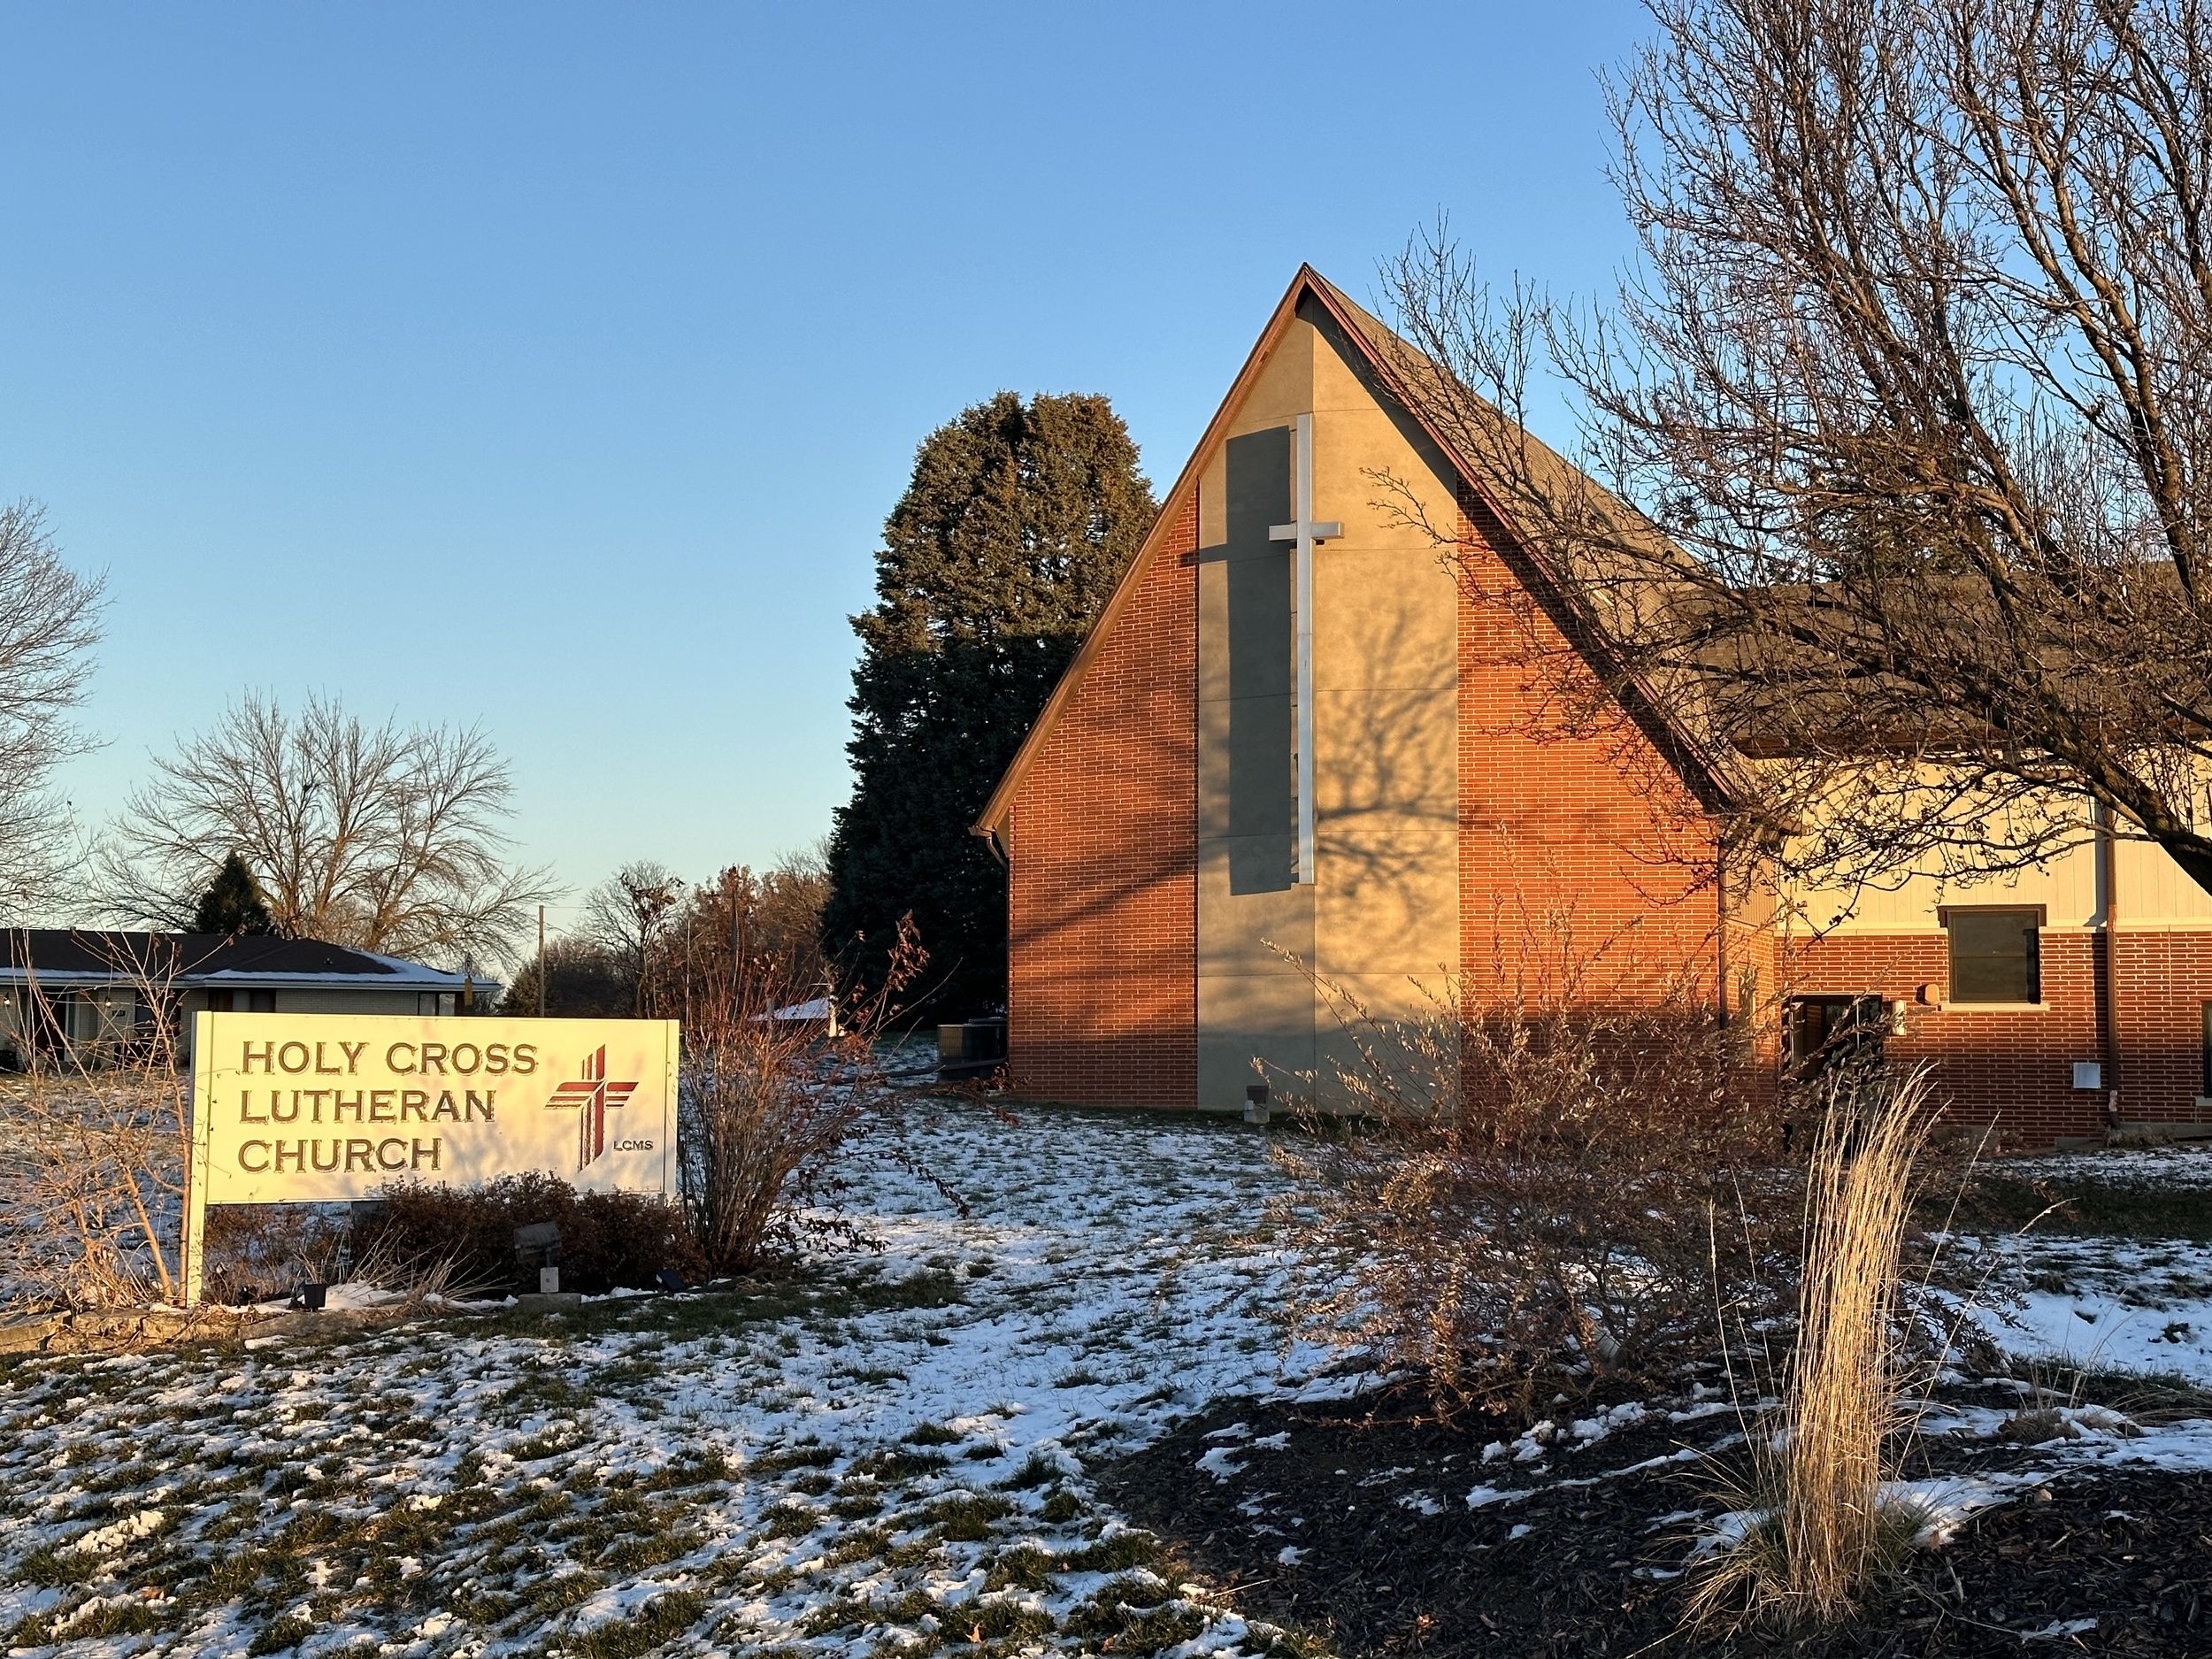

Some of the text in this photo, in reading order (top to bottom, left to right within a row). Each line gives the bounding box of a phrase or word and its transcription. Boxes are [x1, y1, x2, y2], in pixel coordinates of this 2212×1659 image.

[242, 1041, 538, 1075] HOLY CROSS
[240, 1089, 495, 1125] LUTHERAN
[238, 1137, 442, 1173] CHURCH
[613, 1140, 654, 1151] LCMS
